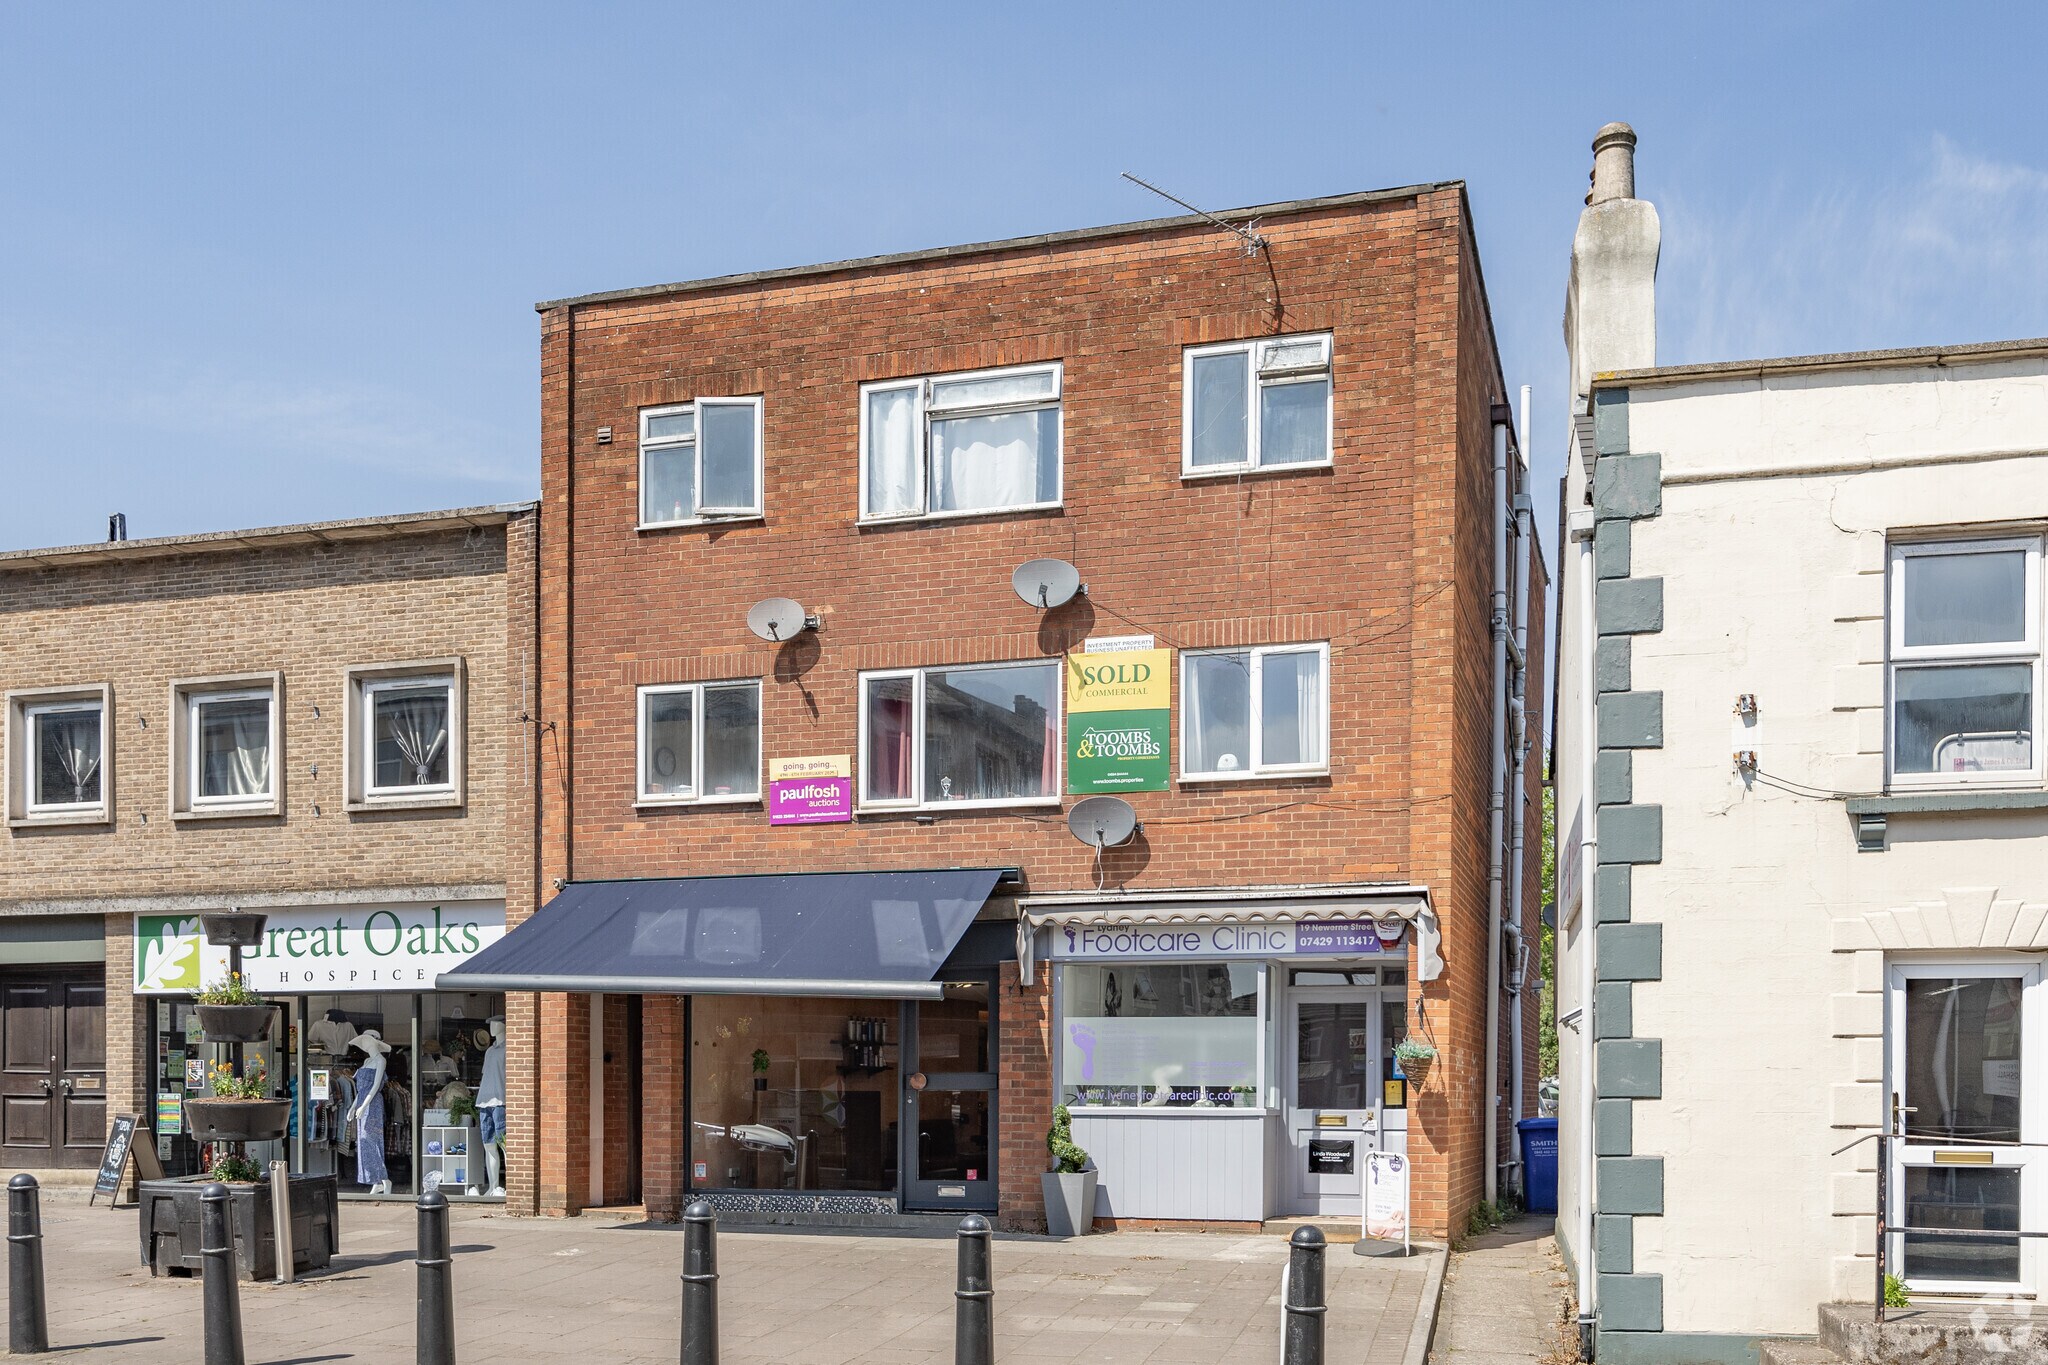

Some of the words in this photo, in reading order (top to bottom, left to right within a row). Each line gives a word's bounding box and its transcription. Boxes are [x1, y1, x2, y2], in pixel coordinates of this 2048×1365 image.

[1087, 641, 1121, 649] INVESTMENT
[1084, 664, 1151, 686] SOLD
[1086, 687, 1148, 697] COMMERCIAL
[1086, 731, 1151, 746] TOOMBS
[1076, 739, 1095, 758] &
[1095, 742, 1160, 757] TOOMBS
[780, 784, 840, 803] paulfosh
[808, 798, 840, 807] auctions
[363, 905, 480, 957] Oaks
[1097, 925, 1130, 933] Lydney
[1300, 924, 1310, 932] 19
[1312, 924, 1349, 932] Newerne
[1082, 928, 1201, 953] Footcare
[1212, 926, 1287, 951] Clinic
[1300, 937, 1333, 946] 07429
[1336, 936, 1375, 946] 113417
[280, 968, 425, 983] HOSPICE
